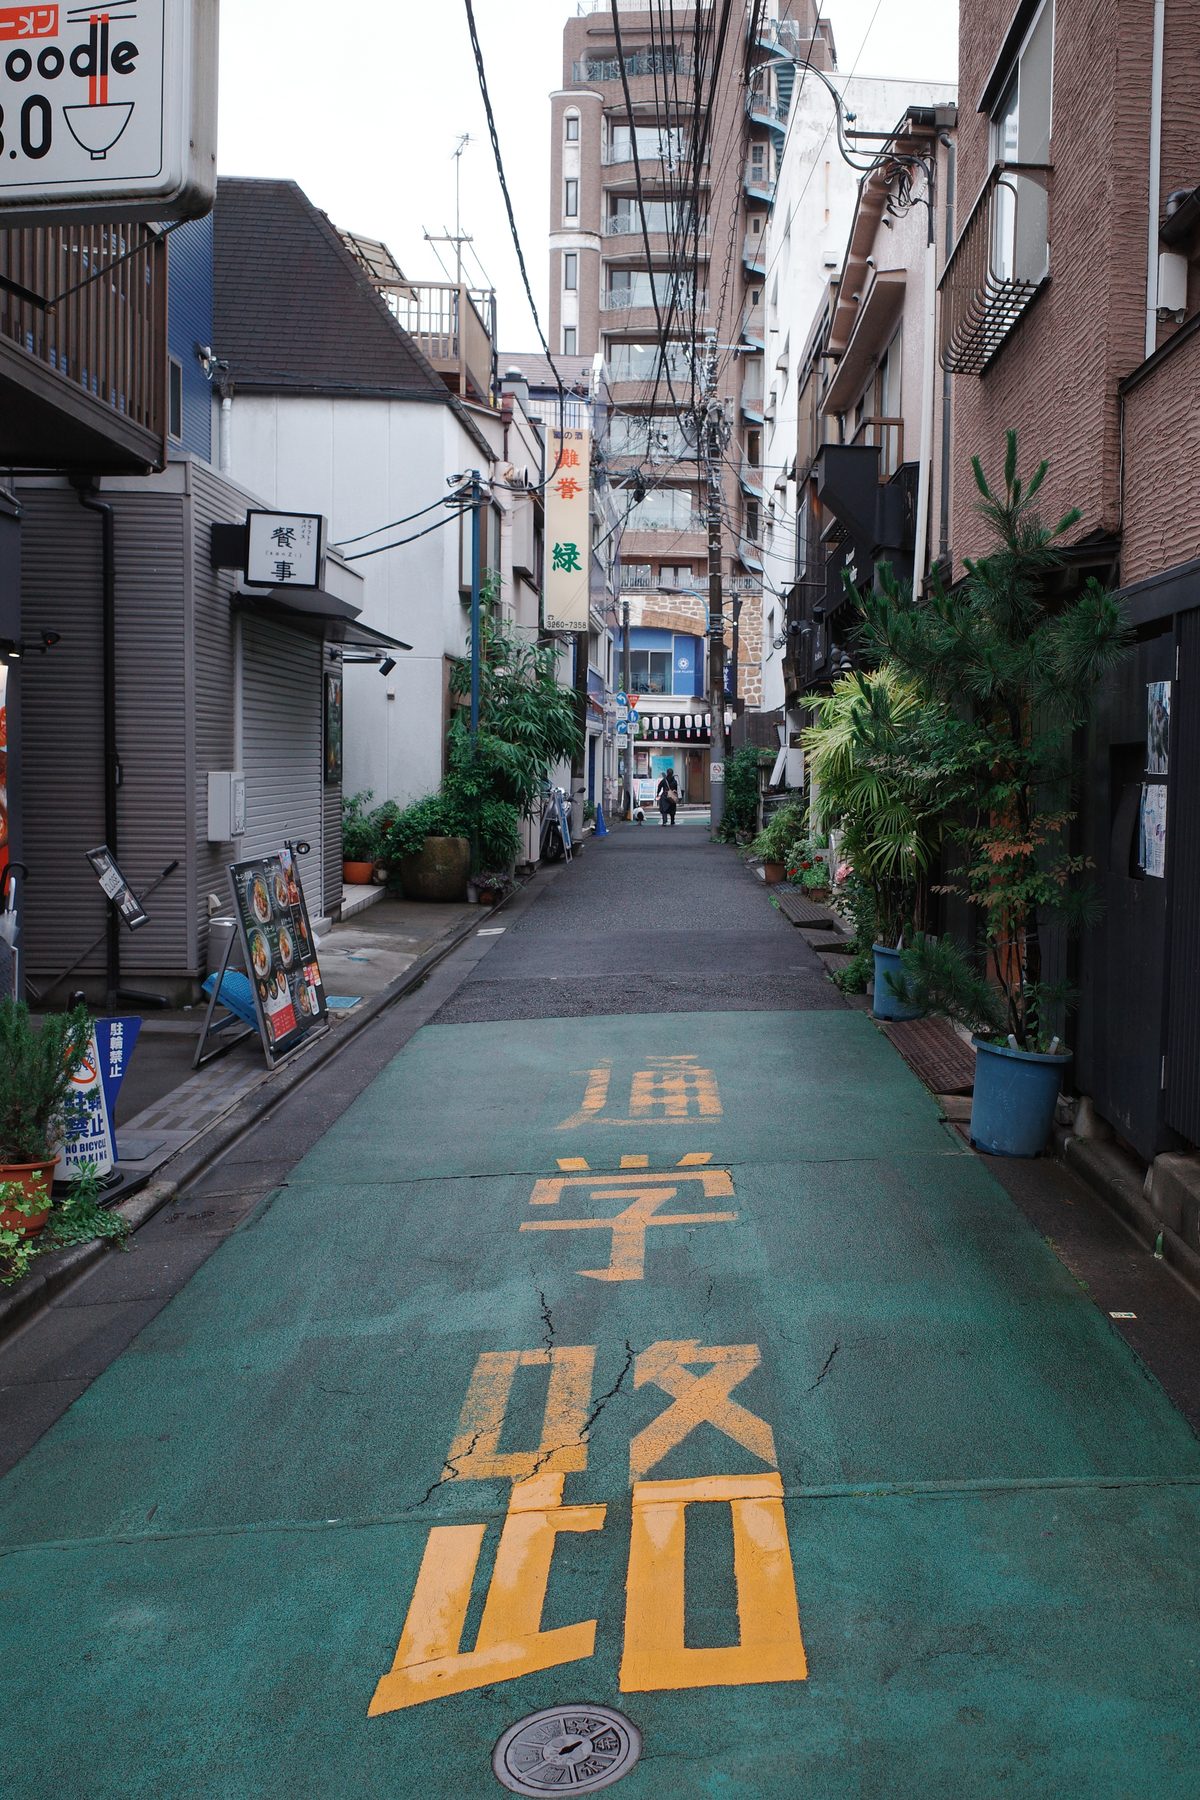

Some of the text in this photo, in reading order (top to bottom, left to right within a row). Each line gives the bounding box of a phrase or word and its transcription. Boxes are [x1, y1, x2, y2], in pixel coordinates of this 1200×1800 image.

[0, 94, 52, 160] .0
[552, 542, 582, 573] 緑
[110, 1022, 124, 1078] 駐輪禁止
[65, 1143, 78, 1155] NO
[367, 1055, 808, 1718] 通学路
